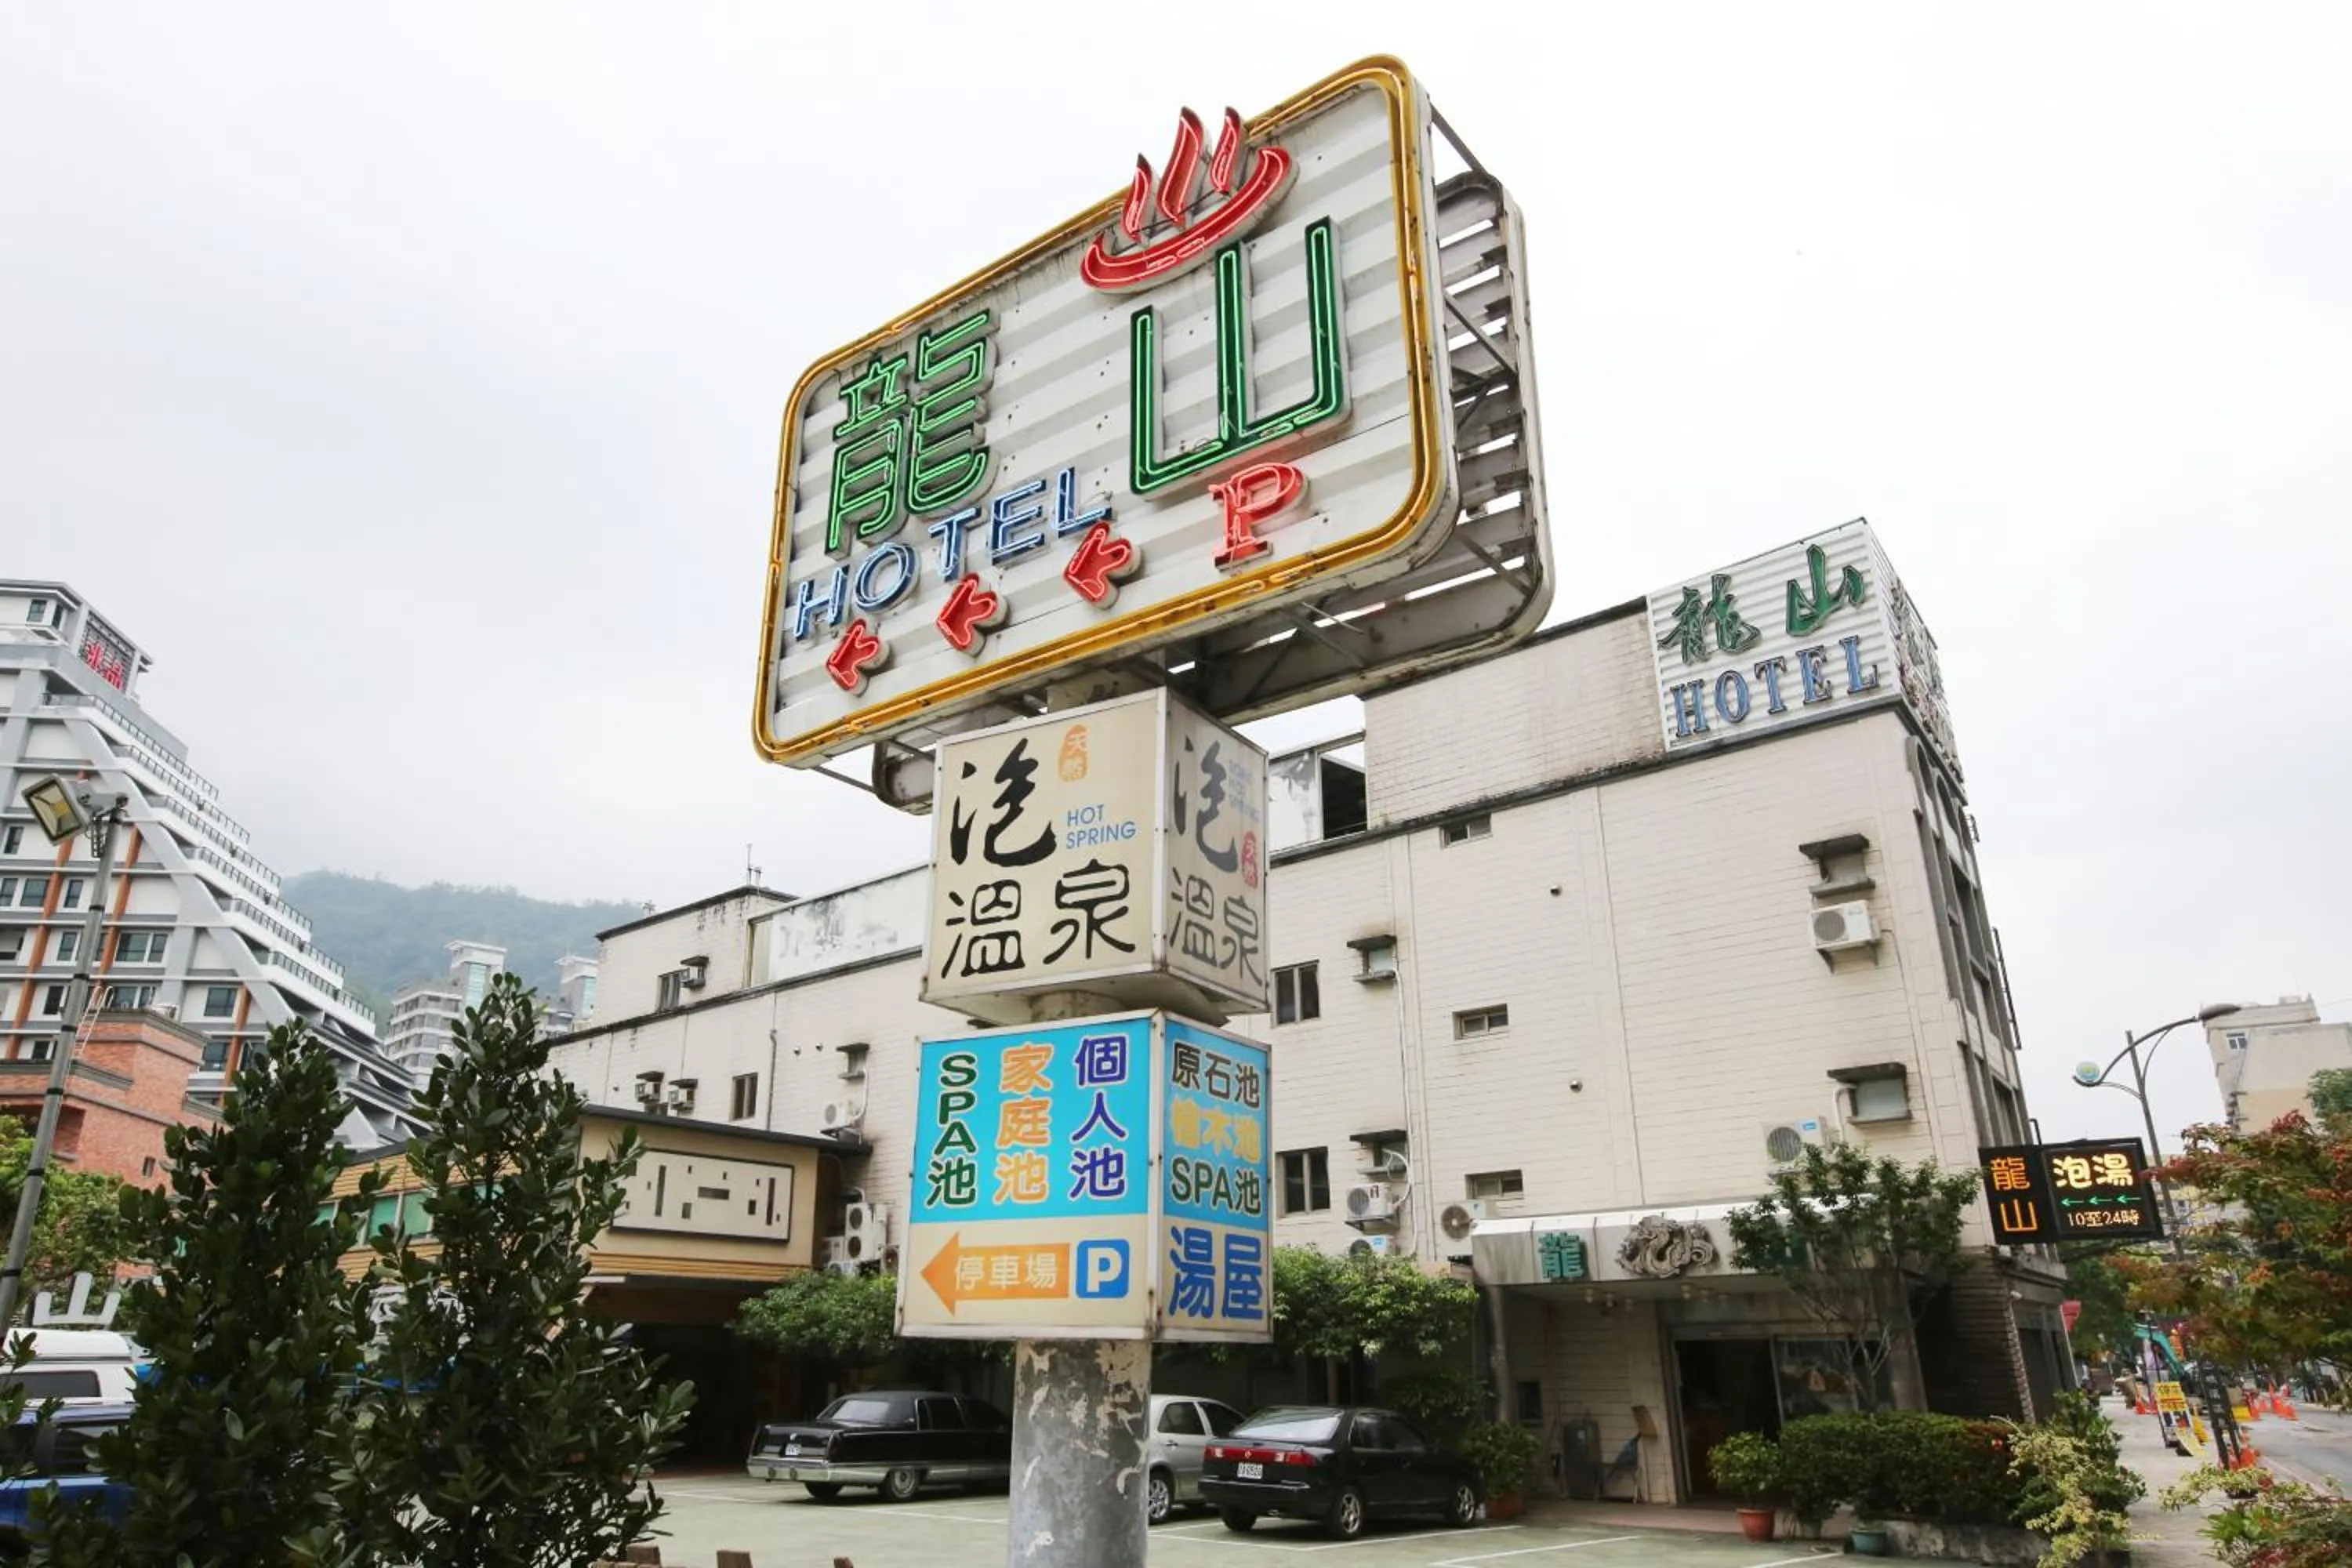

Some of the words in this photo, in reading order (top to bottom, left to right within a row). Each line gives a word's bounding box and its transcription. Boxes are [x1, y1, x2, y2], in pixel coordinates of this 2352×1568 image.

[825, 216, 1342, 551] 龍山
[793, 466, 1112, 641] HOTEL
[1209, 463, 1305, 568] P
[1669, 634, 1879, 738] HOTEL
[1065, 821, 1137, 850] SPRING
[1066, 804, 1105, 827] HOT
[942, 859, 1137, 979] 溫泉
[1171, 1041, 1261, 1109] 原石池
[924, 1053, 978, 1207] SPA池
[994, 1044, 1053, 1203] 家庭池
[1069, 1036, 1127, 1200] 個人池
[1171, 1156, 1261, 1215] SPA池
[1991, 1156, 2038, 1232] 龍山
[2052, 1153, 2132, 1189] 泡湯
[2067, 1210, 2140, 1228] 10至24時
[953, 1253, 1058, 1291] 停車場
[1086, 1247, 1123, 1294] P
[1168, 1226, 1264, 1320] 湯屋
